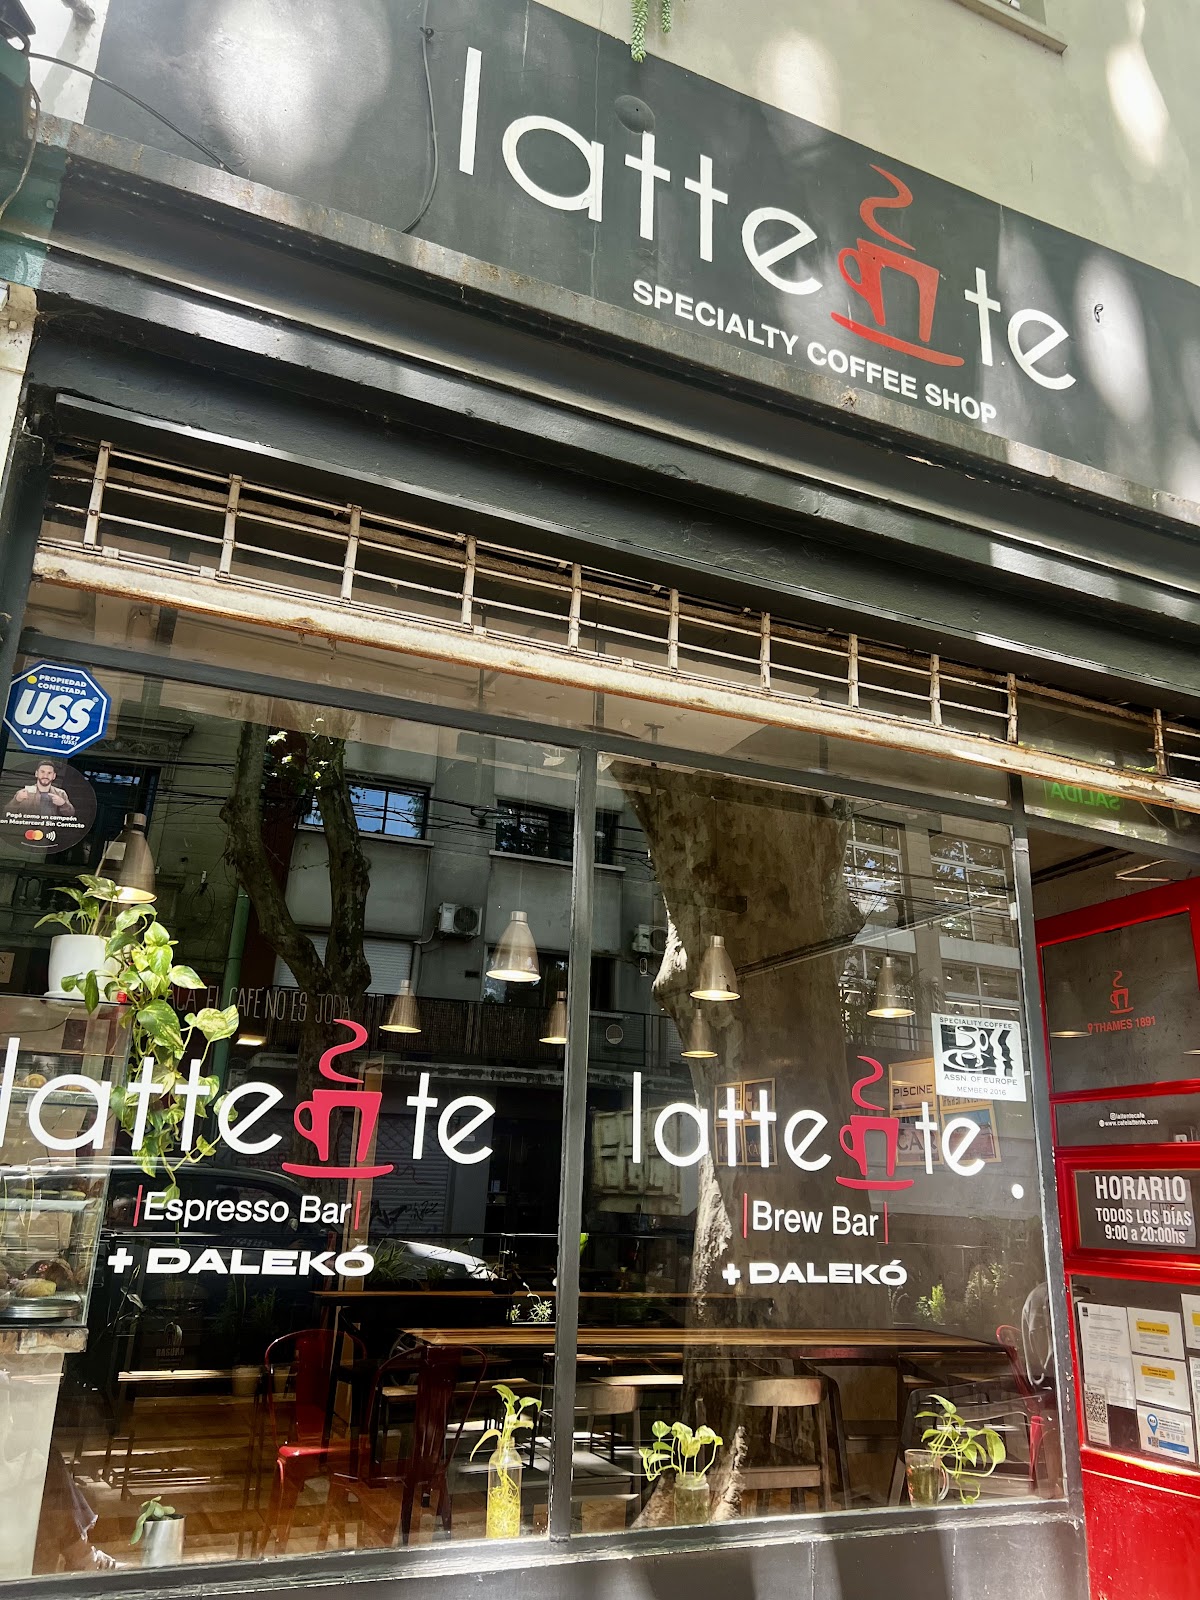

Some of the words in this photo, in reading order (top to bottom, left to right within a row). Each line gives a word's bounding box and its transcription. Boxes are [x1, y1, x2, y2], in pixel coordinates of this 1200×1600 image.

[632, 278, 800, 357] SPECIALTY
[807, 341, 918, 399] COFFEE
[925, 382, 997, 425] SHOP
[37, 682, 87, 696] CONECTADA
[38, 674, 87, 688] PROPIEDAD
[14, 688, 96, 734] USS
[22, 728, 80, 741] 0810-122-0877
[9, 819, 45, 827] Mastercard
[56, 821, 85, 829] Contacto
[265, 989, 286, 1021] NO
[291, 991, 308, 1022] ES
[939, 1016, 983, 1027] SPECIALITY
[983, 1021, 1013, 1030] COFFEE
[1093, 1018, 1133, 1034] THAMES
[1135, 1015, 1157, 1028] 1891
[892, 1083, 933, 1099] PISCINE
[956, 1085, 989, 1095] MEMBER
[990, 1088, 1007, 1096] 2016
[970, 1075, 983, 1083] OF
[983, 1076, 1018, 1086] EUROPE
[1095, 1174, 1187, 1202] HORARIO
[143, 1191, 289, 1228] Espresso
[299, 1194, 352, 1225] Bar
[752, 1200, 824, 1234] Brew
[832, 1205, 879, 1237] Bar
[1095, 1206, 1133, 1224] TODOS
[1136, 1208, 1160, 1226] LOS
[1162, 1206, 1192, 1227] DÍAS
[1105, 1223, 1129, 1241] 9:00
[1131, 1227, 1138, 1241] a
[1140, 1225, 1186, 1245] 20:00hs
[145, 1244, 375, 1276] DALEKÓ
[749, 1259, 908, 1286] DALEKÓ
